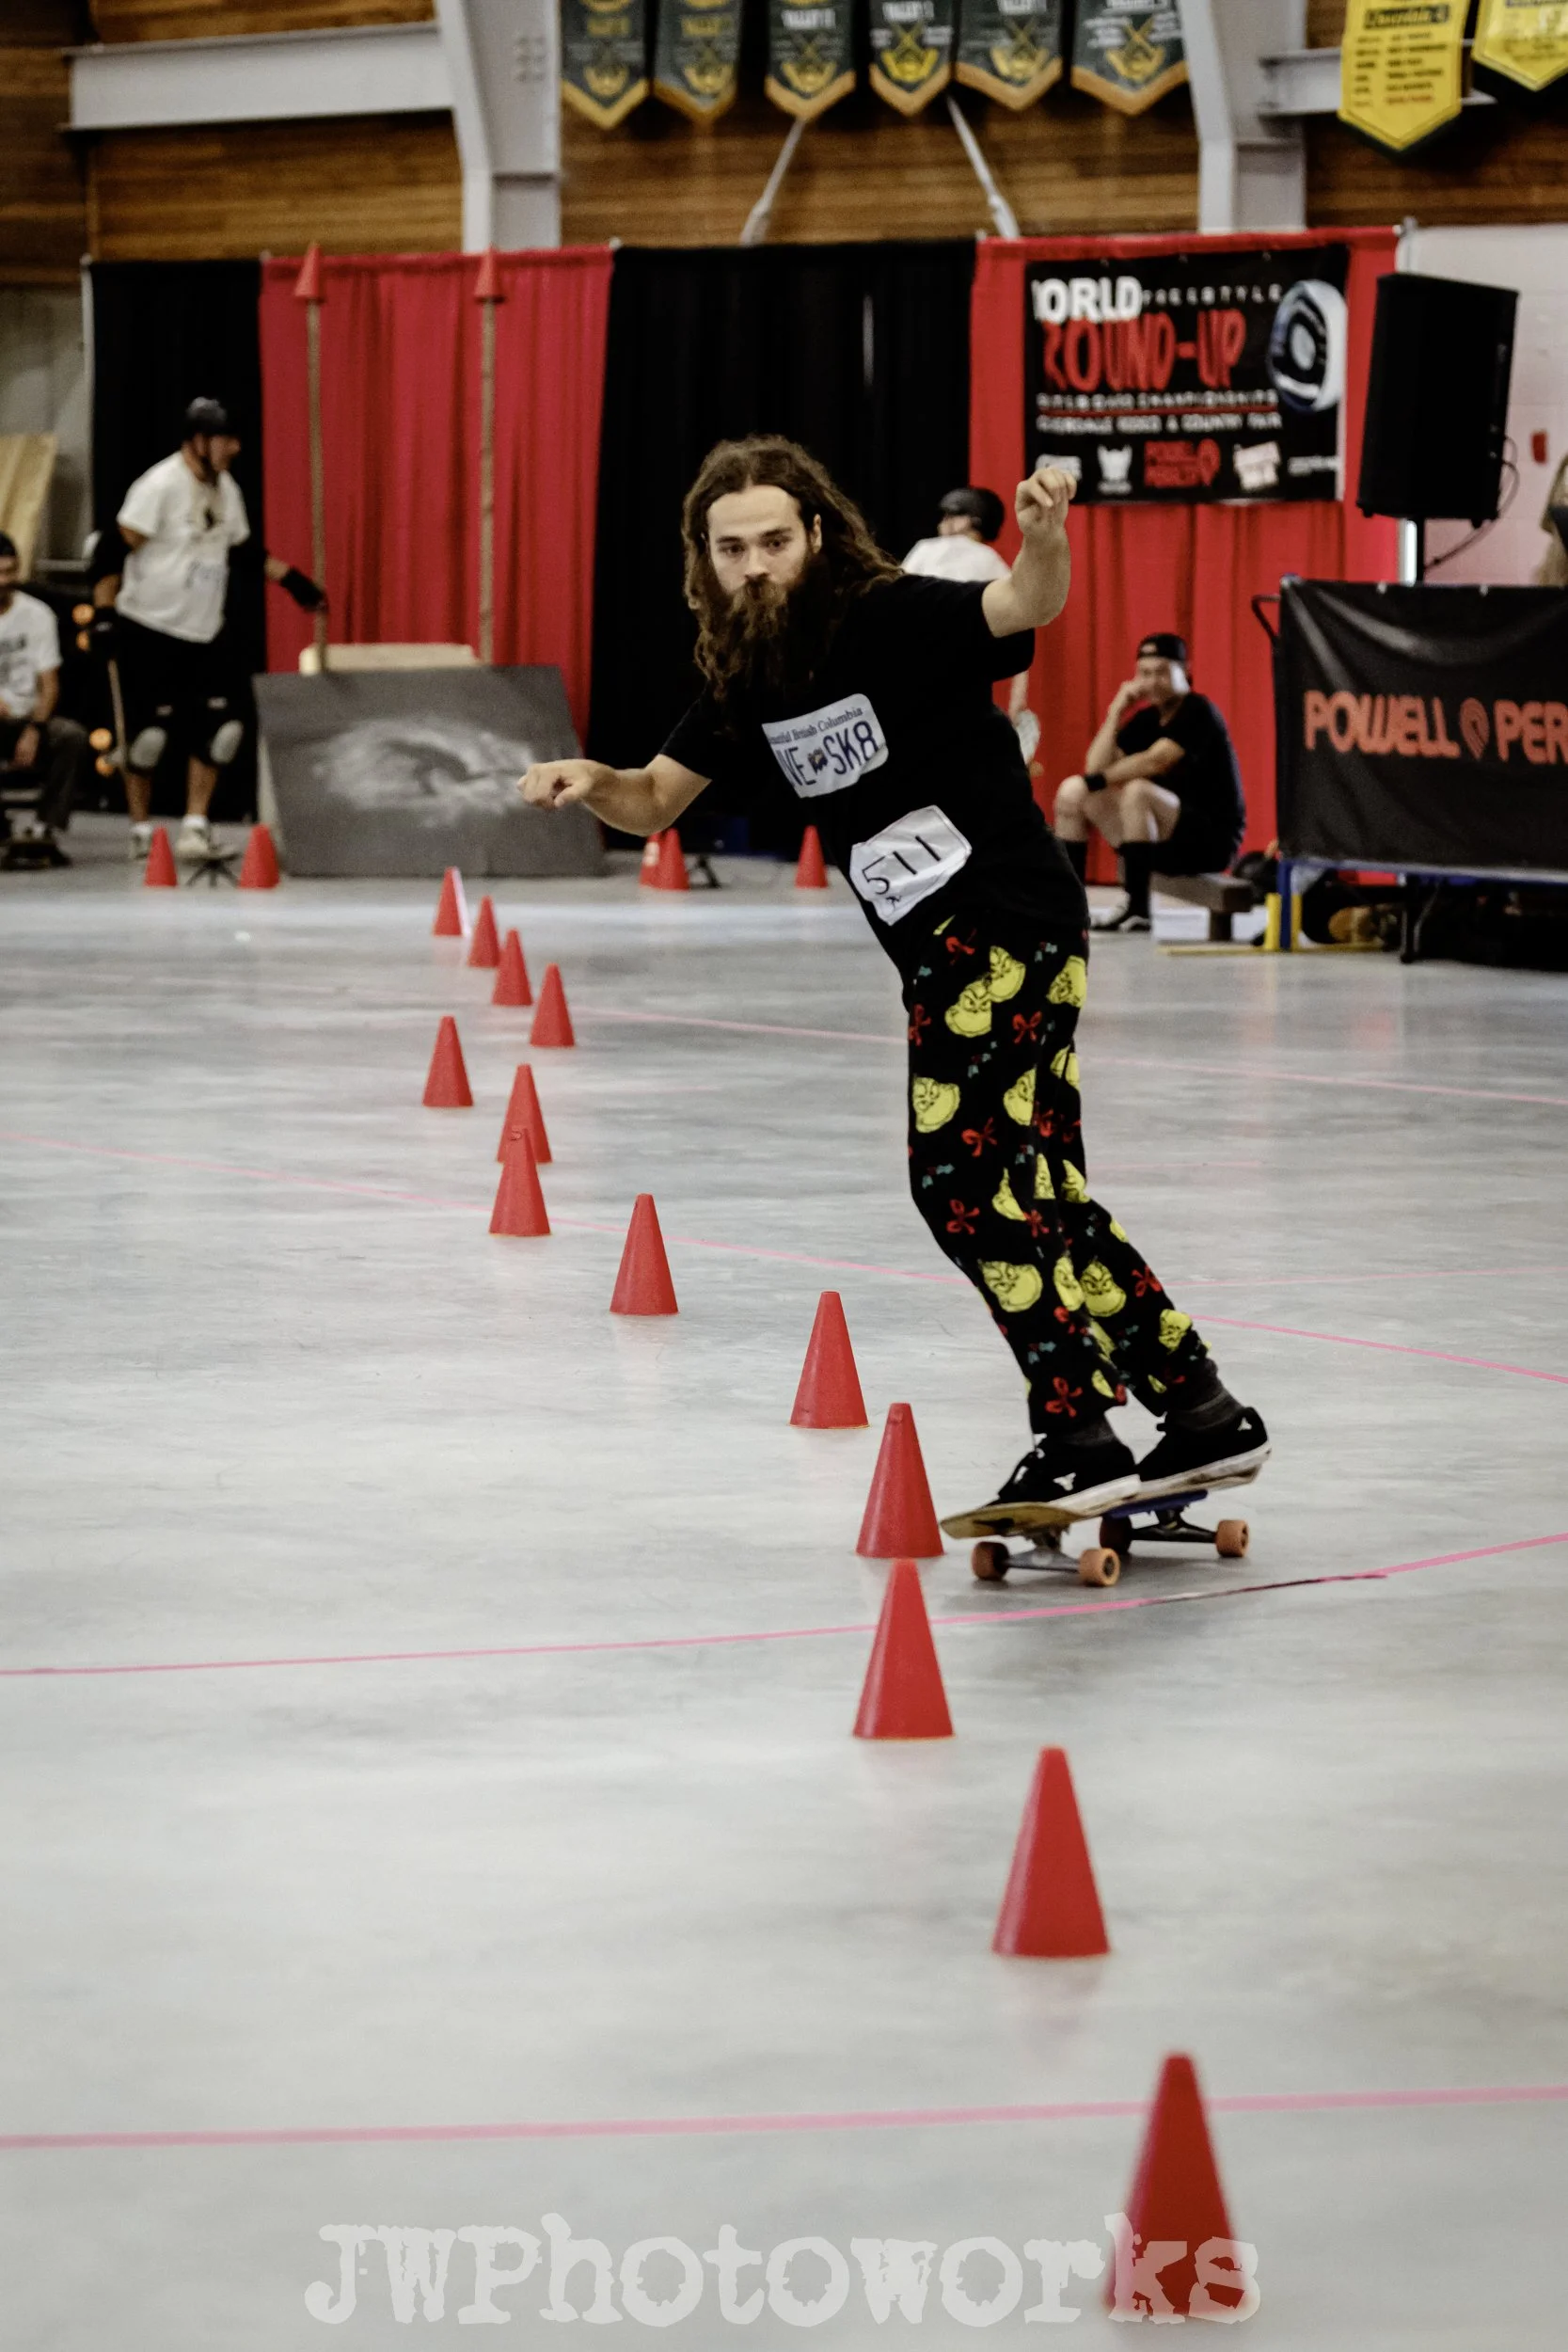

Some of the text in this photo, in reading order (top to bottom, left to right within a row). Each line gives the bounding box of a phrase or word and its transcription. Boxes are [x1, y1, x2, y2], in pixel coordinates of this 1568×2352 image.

[817, 707, 863, 732] Columbia
[823, 721, 879, 775] SK8
[1304, 689, 1461, 758] POWELL
[862, 835, 942, 895] 511
